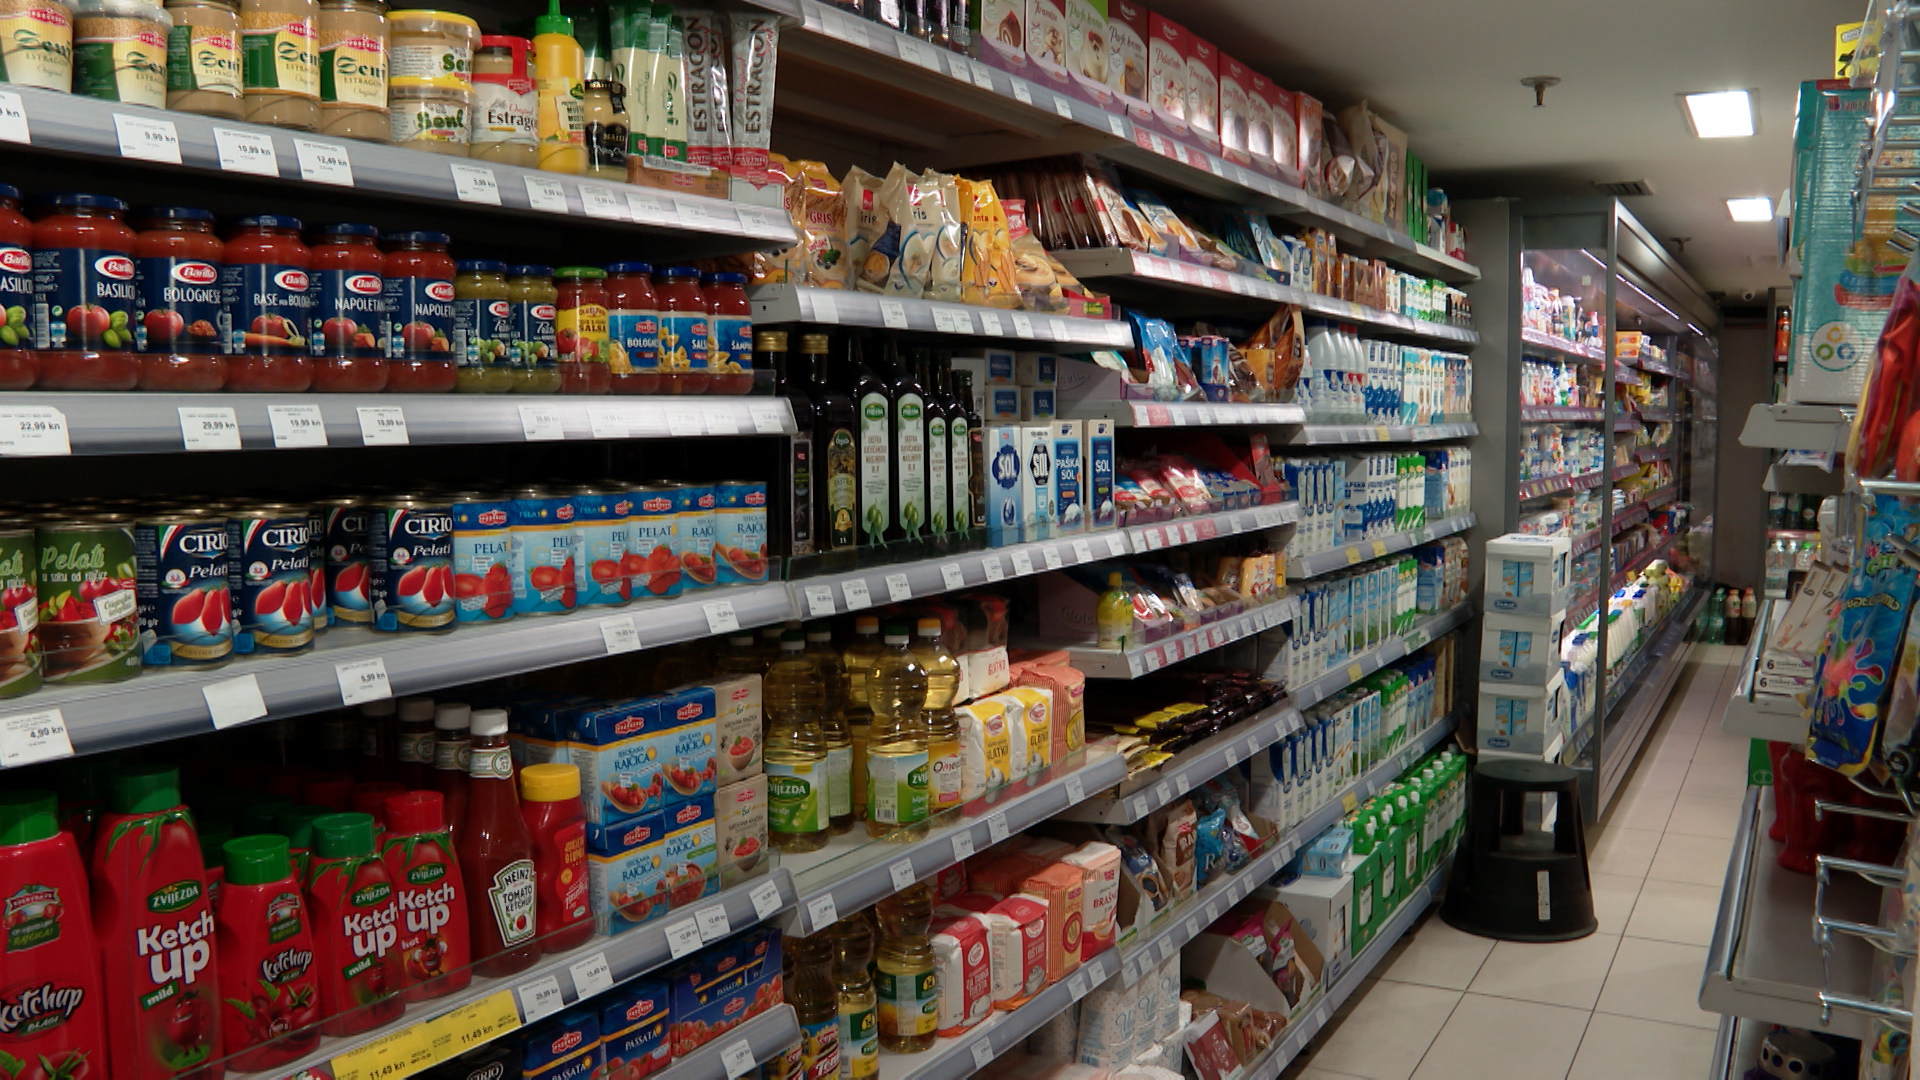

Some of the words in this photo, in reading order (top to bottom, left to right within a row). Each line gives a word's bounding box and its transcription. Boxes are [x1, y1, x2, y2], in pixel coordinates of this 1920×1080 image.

[686, 17, 708, 132] ESTRAGON
[745, 19, 765, 134] ESTRAGON
[183, 266, 216, 278] Barilla
[1000, 455, 1017, 480] SOL
[1034, 453, 1049, 477] SOL
[1056, 455, 1080, 470] PAŠKA
[1095, 459, 1111, 473] SOL
[1061, 469, 1076, 480] SOL
[404, 516, 453, 534] CIRIO
[179, 533, 229, 553] CIRIO
[262, 526, 309, 547] CIRIO
[41, 541, 105, 570] Pelati
[412, 543, 451, 557] Pelati
[189, 563, 228, 579] Pelati
[271, 555, 309, 570] Pelati
[51, 572, 68, 582] soku
[410, 867, 445, 882] ZVIJEZDA
[504, 869, 530, 886] HEINZ
[152, 885, 200, 909] ZVIJEZDA
[354, 884, 391, 905] ZVIJEZDA
[398, 882, 456, 912] Ketch
[502, 884, 533, 905] TOMATO
[505, 894, 532, 913] KETCHUP
[343, 901, 399, 936] Ketch
[406, 903, 450, 935] up
[137, 909, 215, 957] Ketch
[352, 924, 398, 958] up
[150, 939, 211, 985] up
[348, 959, 372, 977] mild
[146, 985, 175, 1006] mild
[482, 1025, 494, 1035] kn
[625, 1030, 658, 1051] PASSATA
